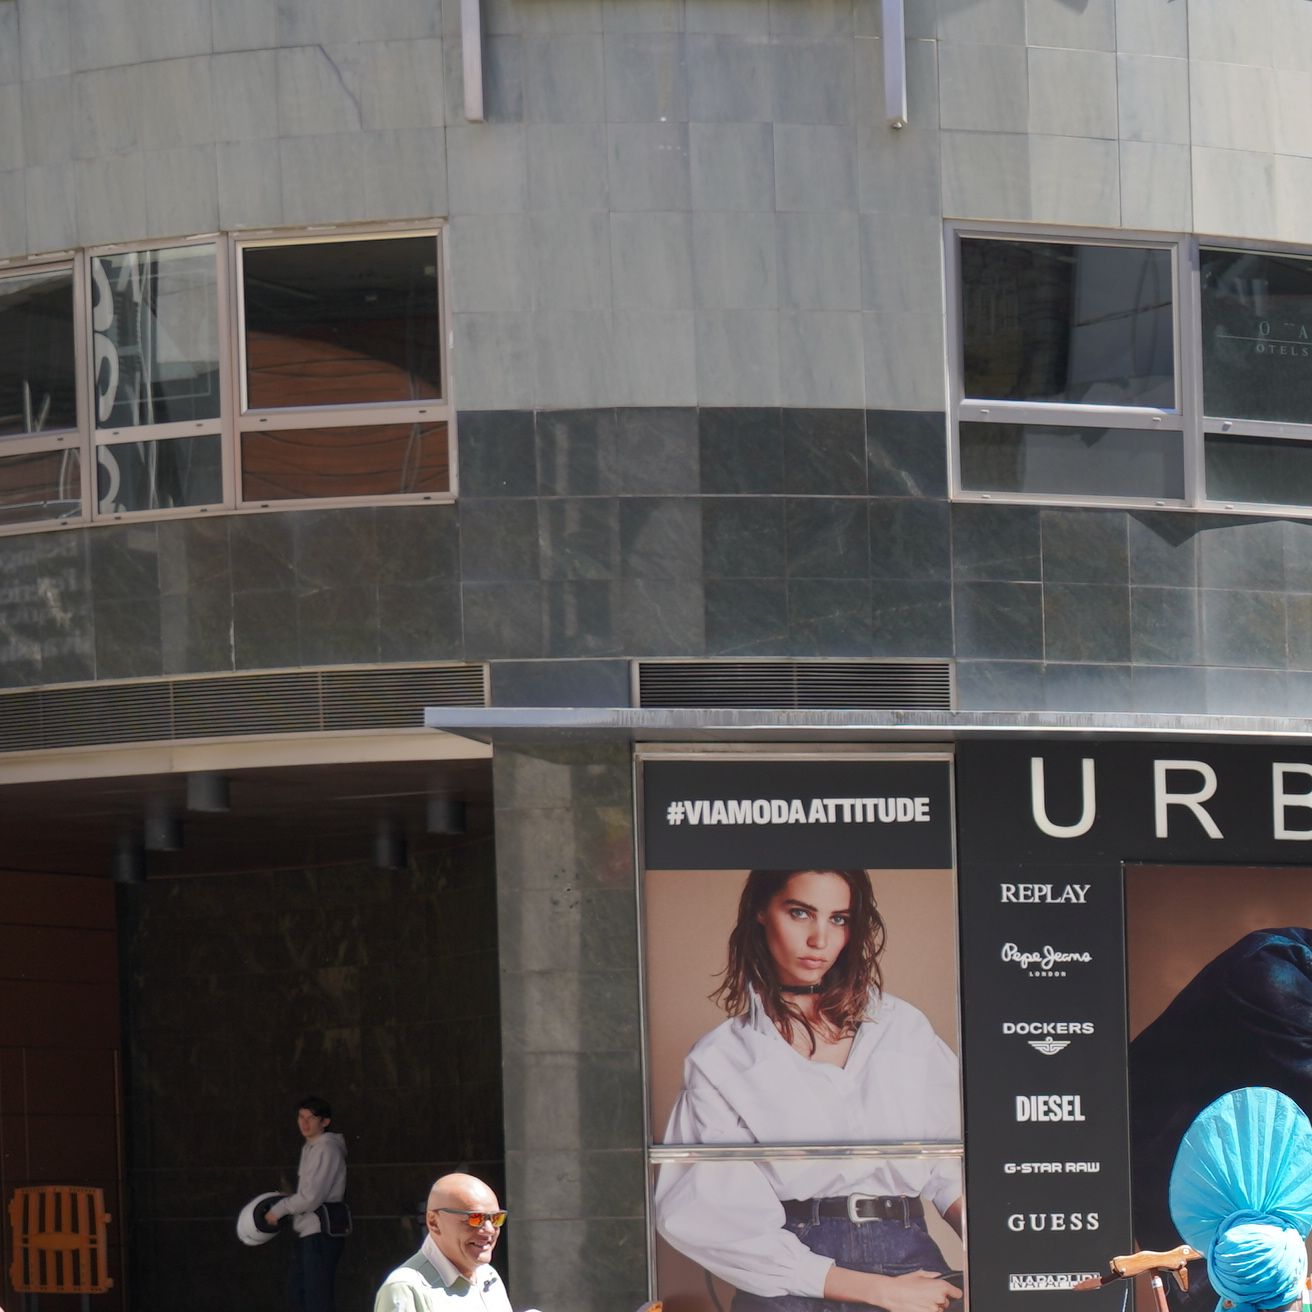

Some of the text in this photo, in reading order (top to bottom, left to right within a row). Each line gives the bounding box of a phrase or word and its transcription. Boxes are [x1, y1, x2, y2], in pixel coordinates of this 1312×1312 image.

[1000, 883, 1091, 903] REPLAY
[1001, 942, 1093, 970] Pepe Jeans
[1002, 1022, 1095, 1034] DOCKERS
[1015, 1094, 1086, 1122] DIESEL
[1004, 1161, 1100, 1173] G-STAR RAW
[1007, 1212, 1099, 1231] GUESS
